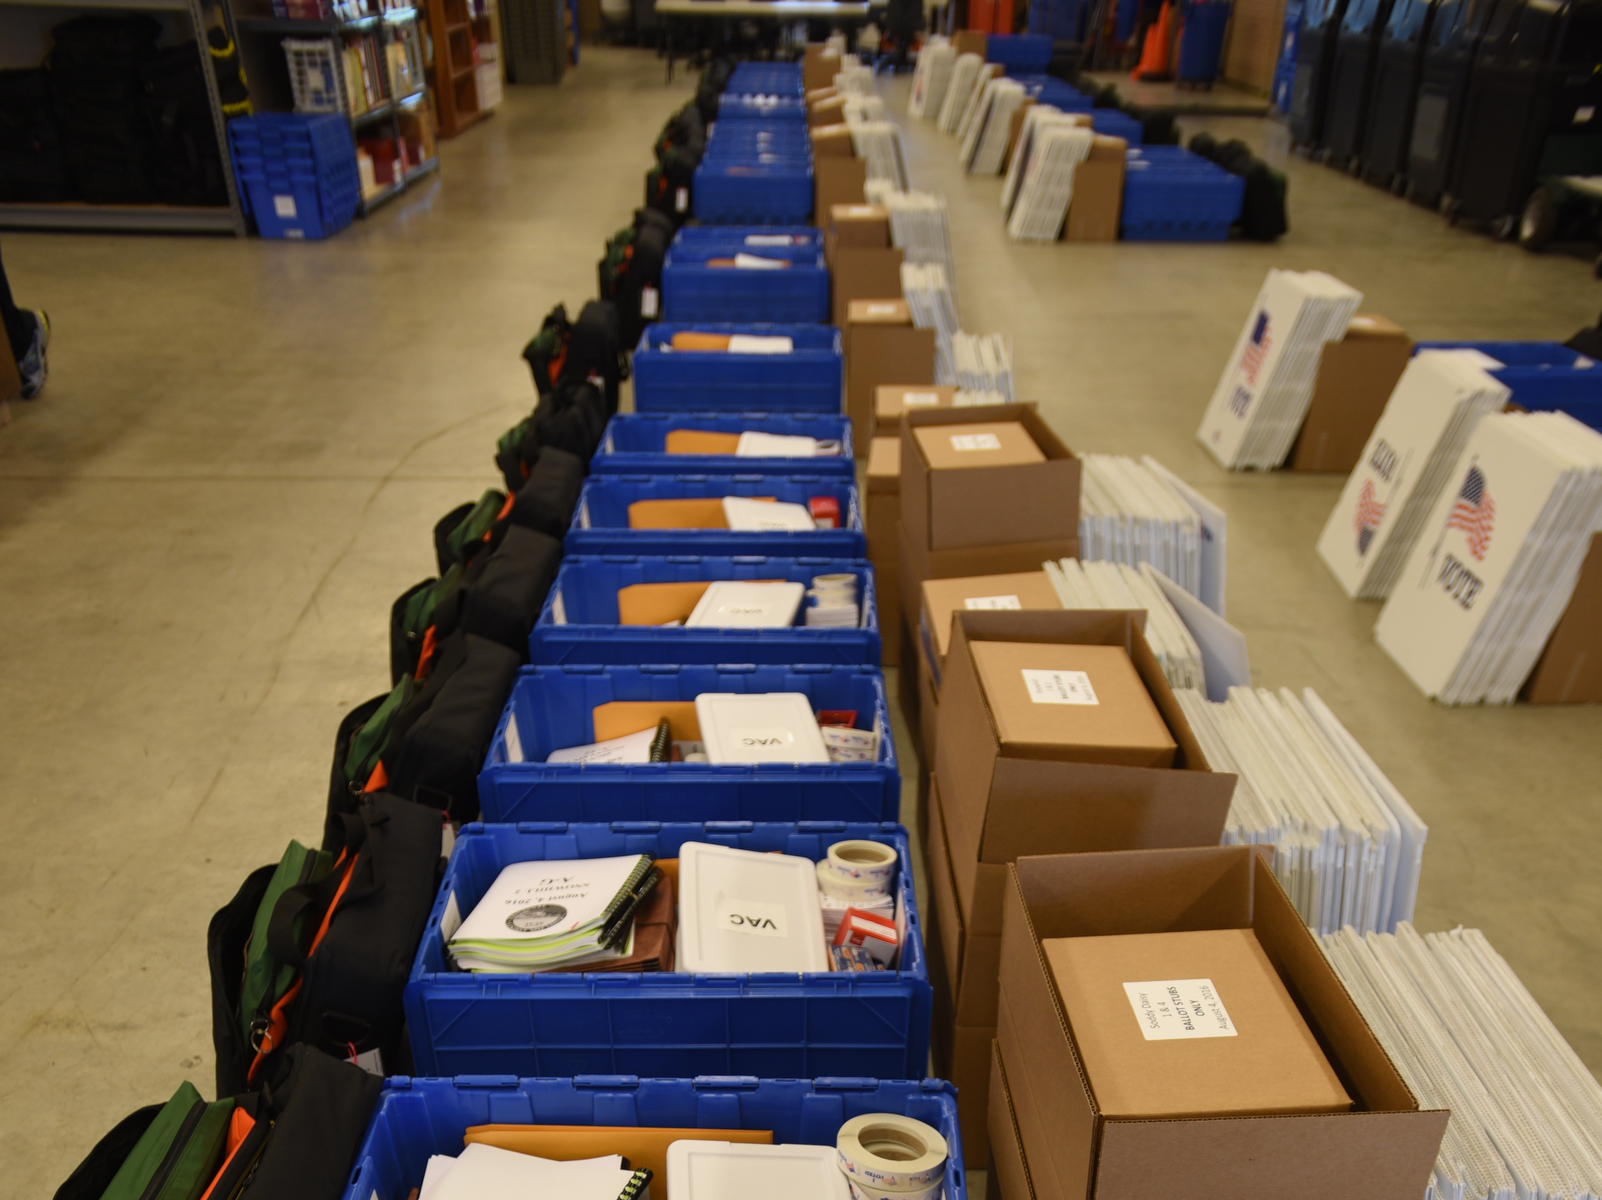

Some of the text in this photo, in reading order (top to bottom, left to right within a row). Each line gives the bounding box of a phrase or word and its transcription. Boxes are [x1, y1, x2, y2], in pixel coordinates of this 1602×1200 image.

[1437, 552, 1484, 611] VOTE
[742, 737, 783, 746] VAC
[548, 892, 588, 901] August
[729, 914, 778, 930] VAC
[1199, 985, 1214, 1000] 2016
[1139, 993, 1160, 1029] Soddy Daisy
[1167, 986, 1195, 1031] BALLOT STUBS
[1189, 999, 1205, 1017] ONLY
[1211, 1008, 1229, 1030] August
[865, 1171, 884, 1180] VOTED
